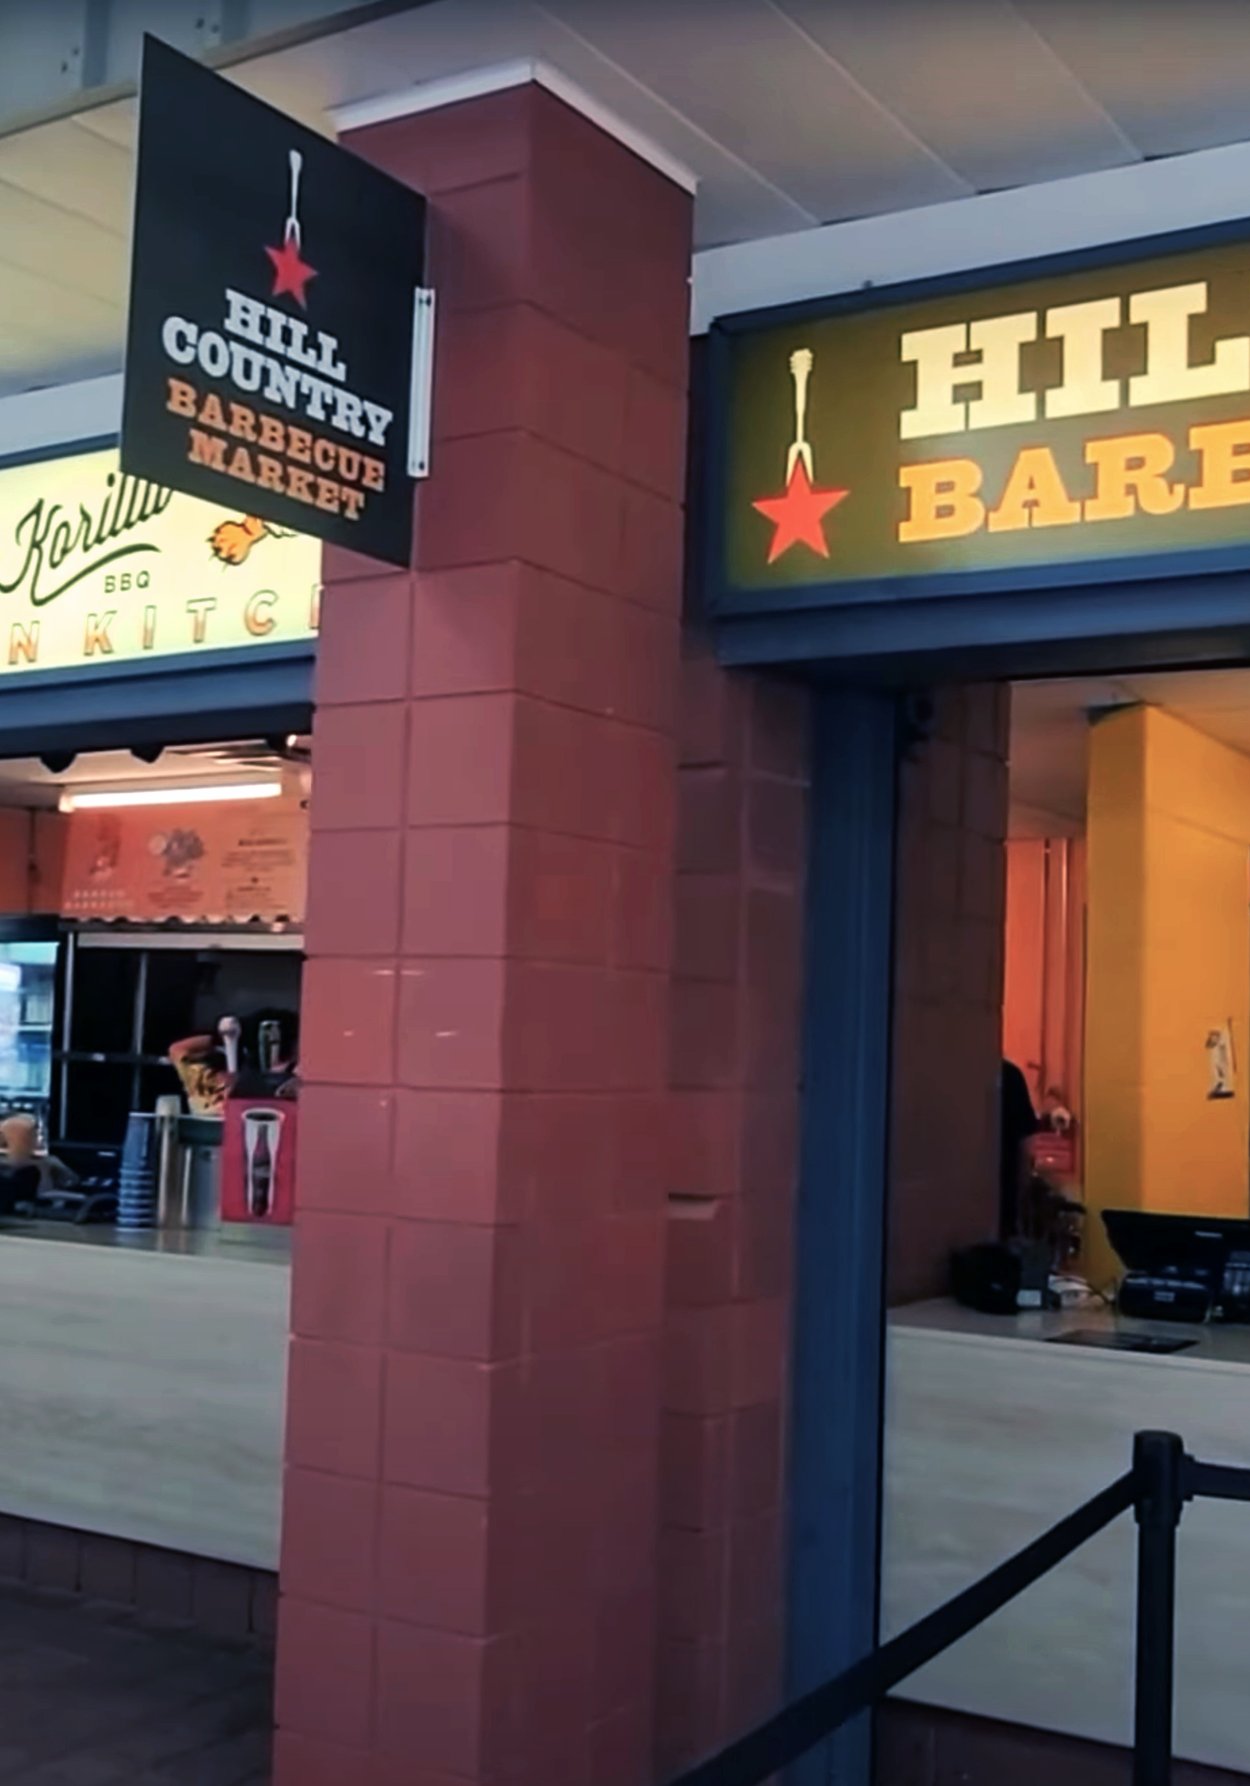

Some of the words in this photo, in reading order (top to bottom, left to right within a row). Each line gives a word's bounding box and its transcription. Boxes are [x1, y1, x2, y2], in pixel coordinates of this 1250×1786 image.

[162, 316, 394, 447] COUNTRY
[224, 288, 347, 382] HILL
[166, 377, 385, 492] BARBECUE
[188, 428, 365, 521] MARKET
[83, 583, 322, 656] KITC
[104, 570, 151, 593] BBQ
